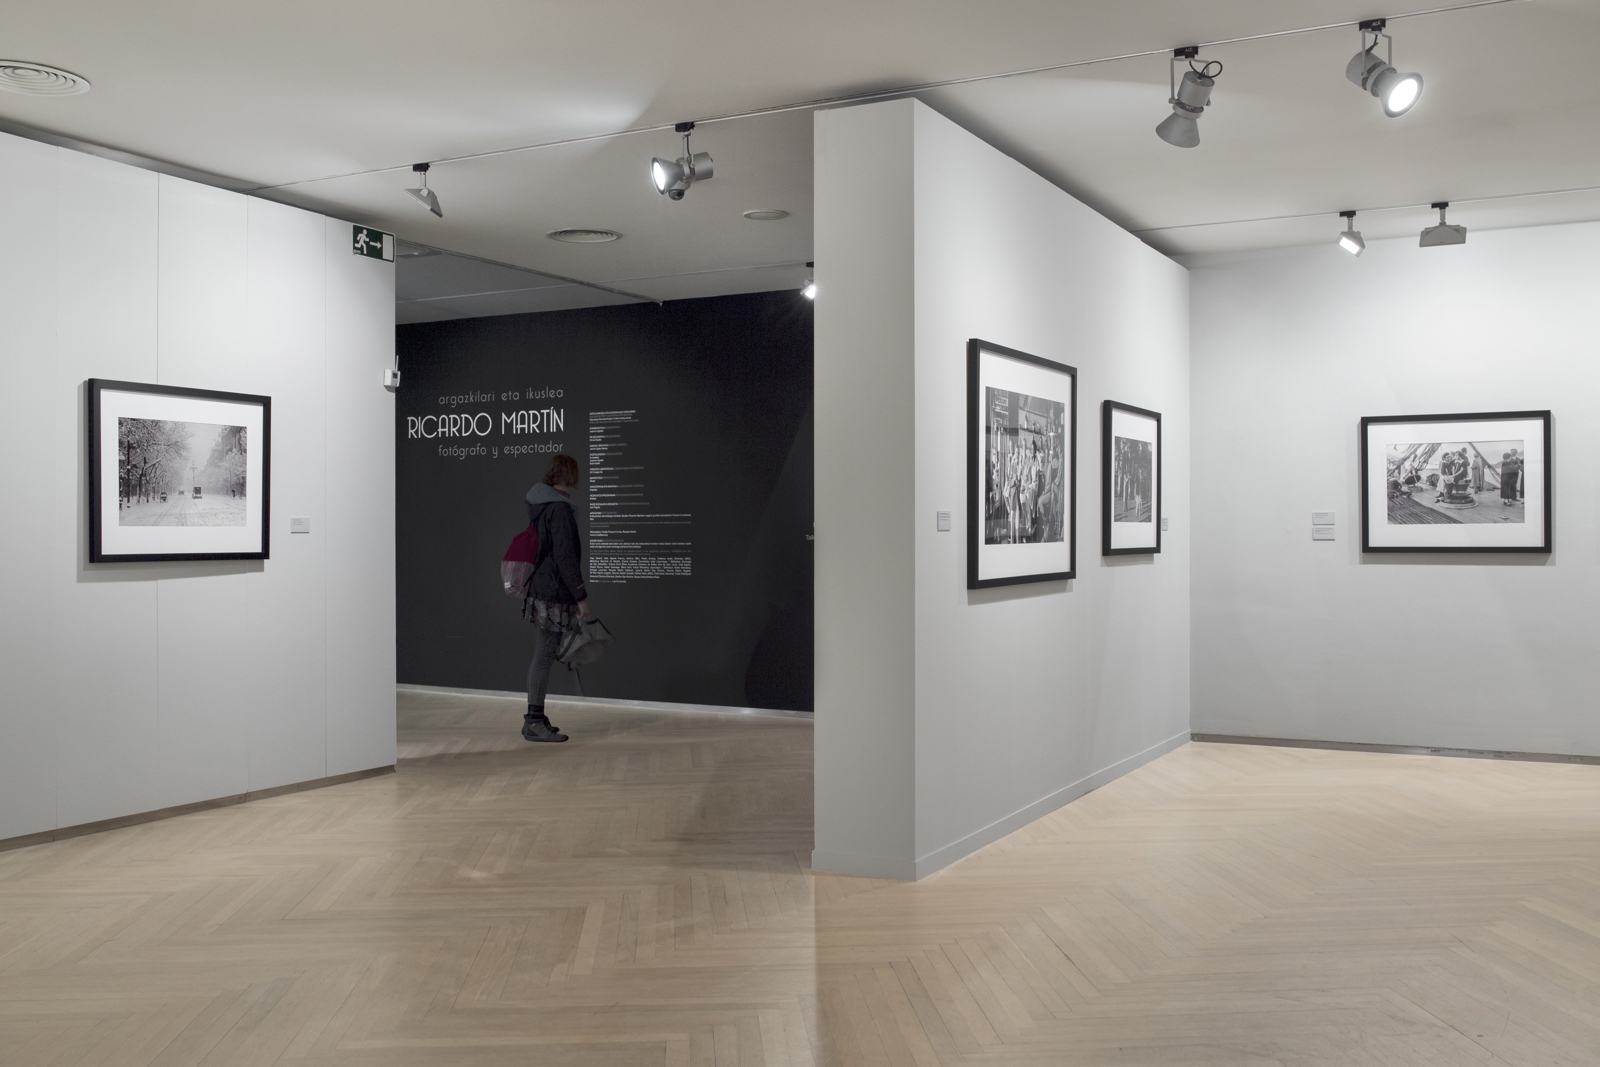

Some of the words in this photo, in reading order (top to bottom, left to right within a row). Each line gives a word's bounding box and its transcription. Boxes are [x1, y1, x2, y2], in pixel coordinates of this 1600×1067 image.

[438, 390, 495, 408] argazkilari
[501, 391, 520, 402] eta
[526, 386, 564, 400] ikuslea
[407, 412, 492, 439] RICARDO
[501, 406, 564, 435] MARTÍN
[438, 443, 487, 460] fotógrafo
[492, 446, 499, 459] y
[503, 440, 563, 458] espectador
